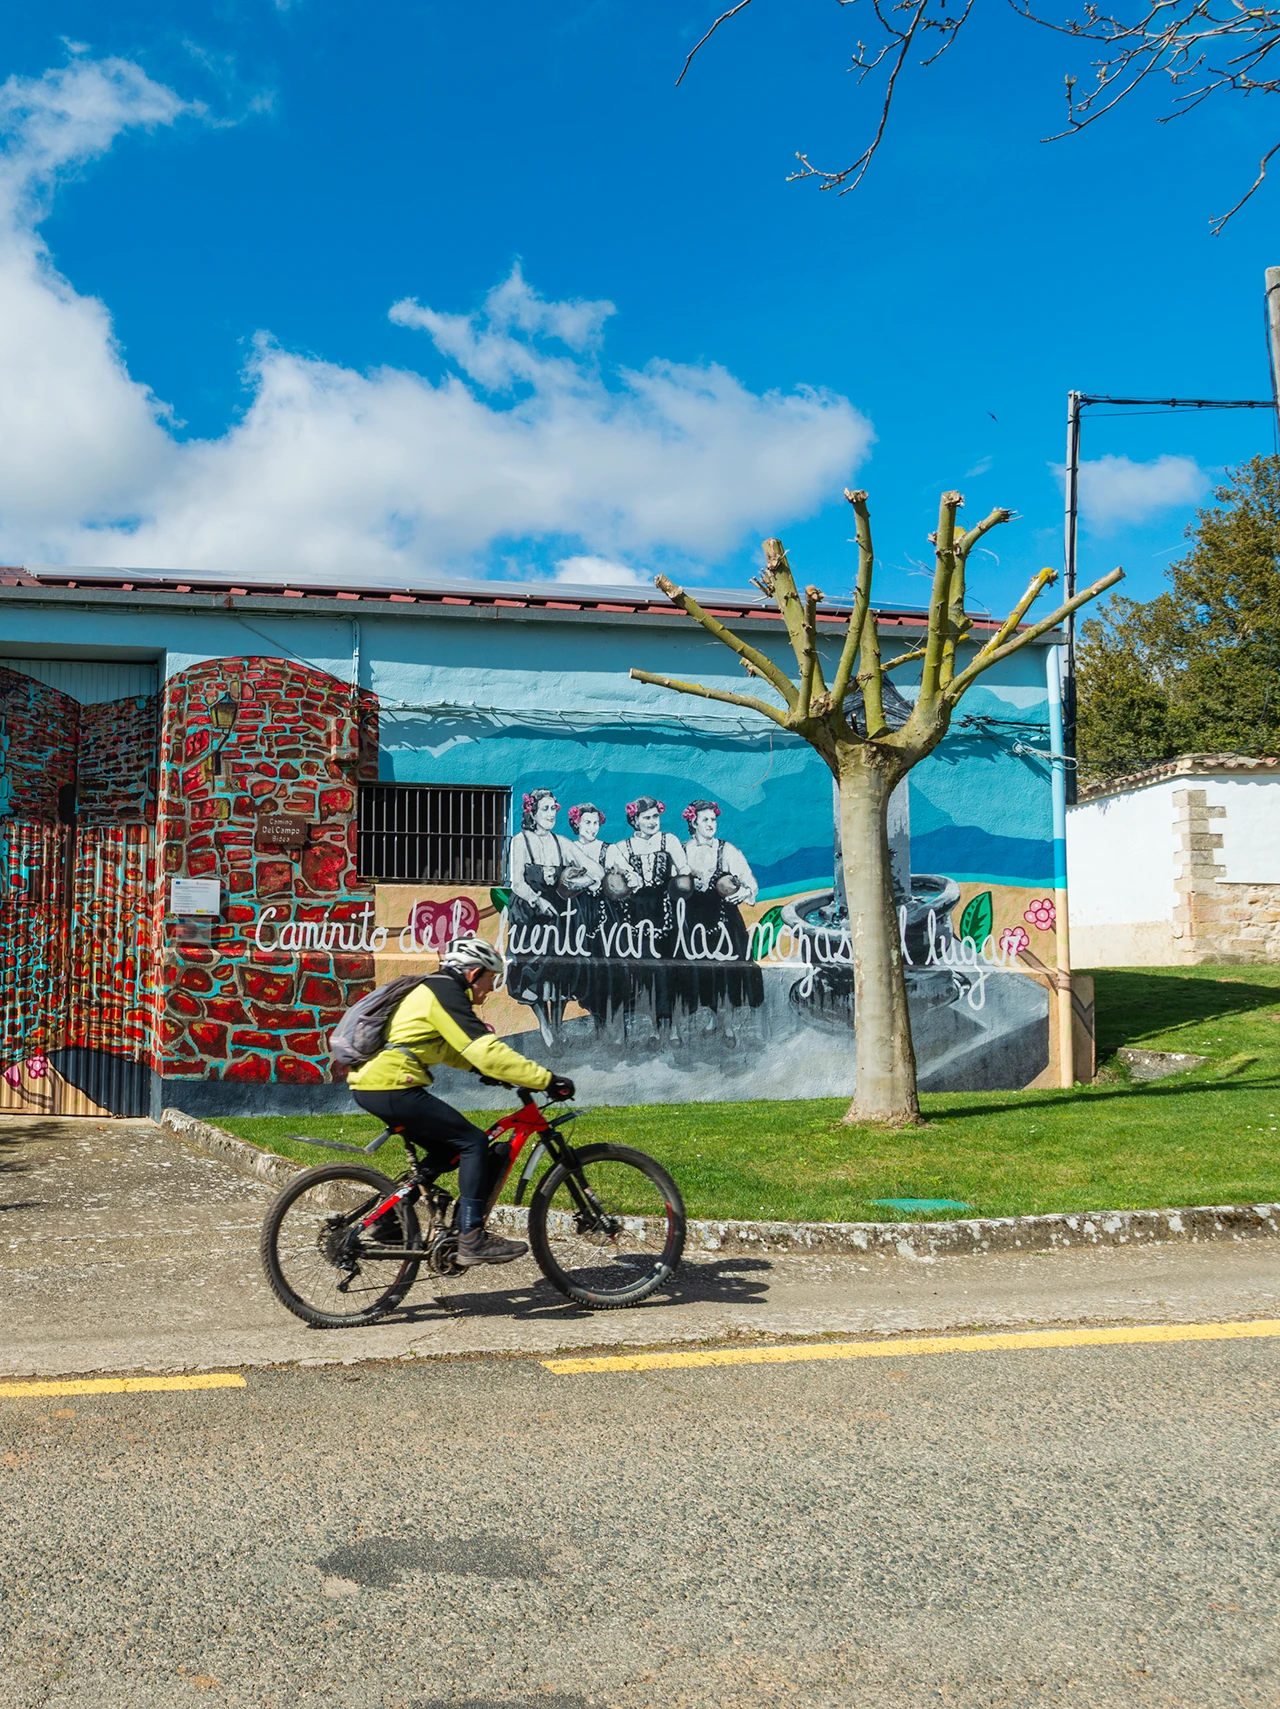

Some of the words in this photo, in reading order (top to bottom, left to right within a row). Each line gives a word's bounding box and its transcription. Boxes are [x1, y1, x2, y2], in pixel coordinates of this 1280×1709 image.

[262, 826, 275, 834] Del
[275, 826, 300, 835] Campo
[255, 901, 389, 952] Caminito
[399, 898, 439, 953] de
[492, 898, 592, 992] fuente
[599, 919, 661, 959] van
[672, 897, 740, 961] las
[746, 921, 854, 998] mozas
[924, 908, 1021, 1011] lugar
